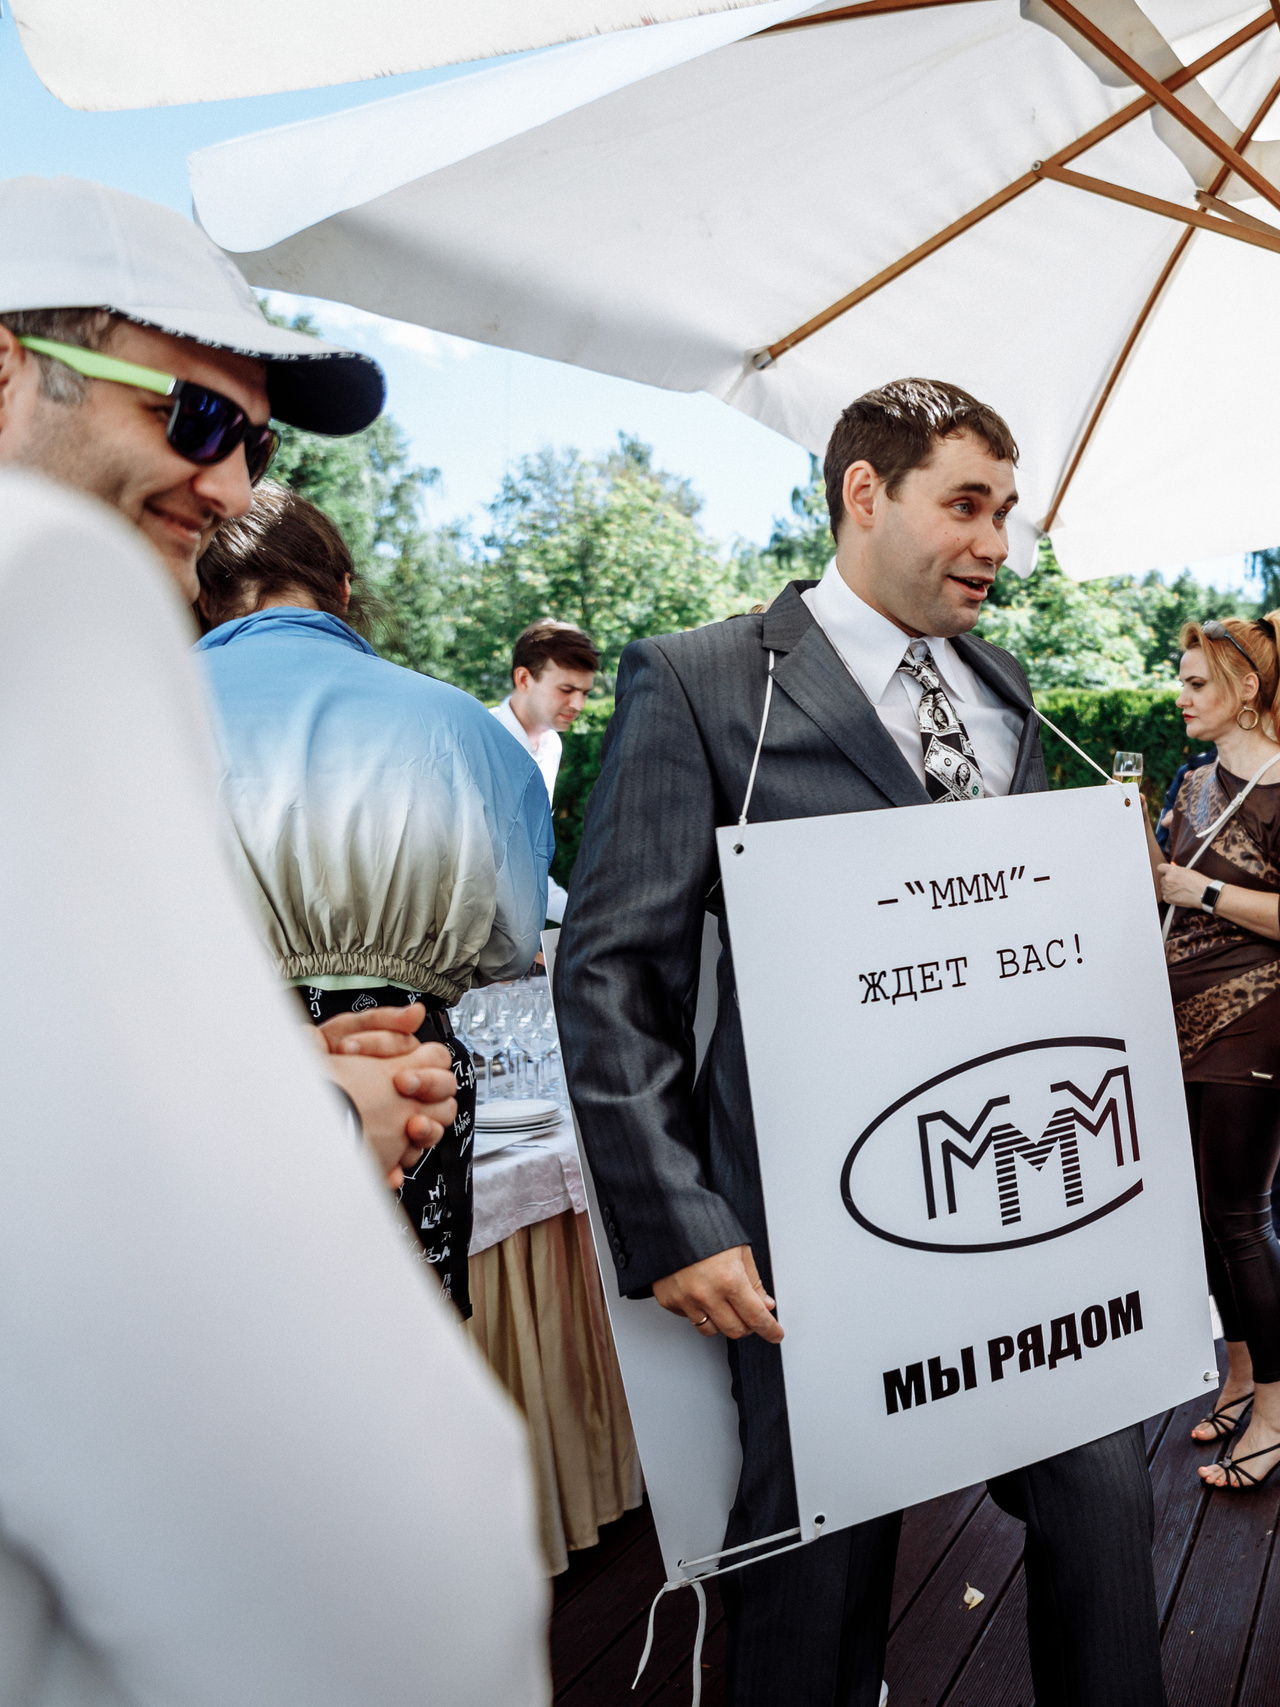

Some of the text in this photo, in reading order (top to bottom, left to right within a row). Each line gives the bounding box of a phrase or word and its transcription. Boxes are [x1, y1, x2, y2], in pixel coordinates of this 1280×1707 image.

[858, 933, 1083, 1006] ЖДЕТ ВАС!
[882, 1290, 1144, 1416] МЫ РЯДОМ
